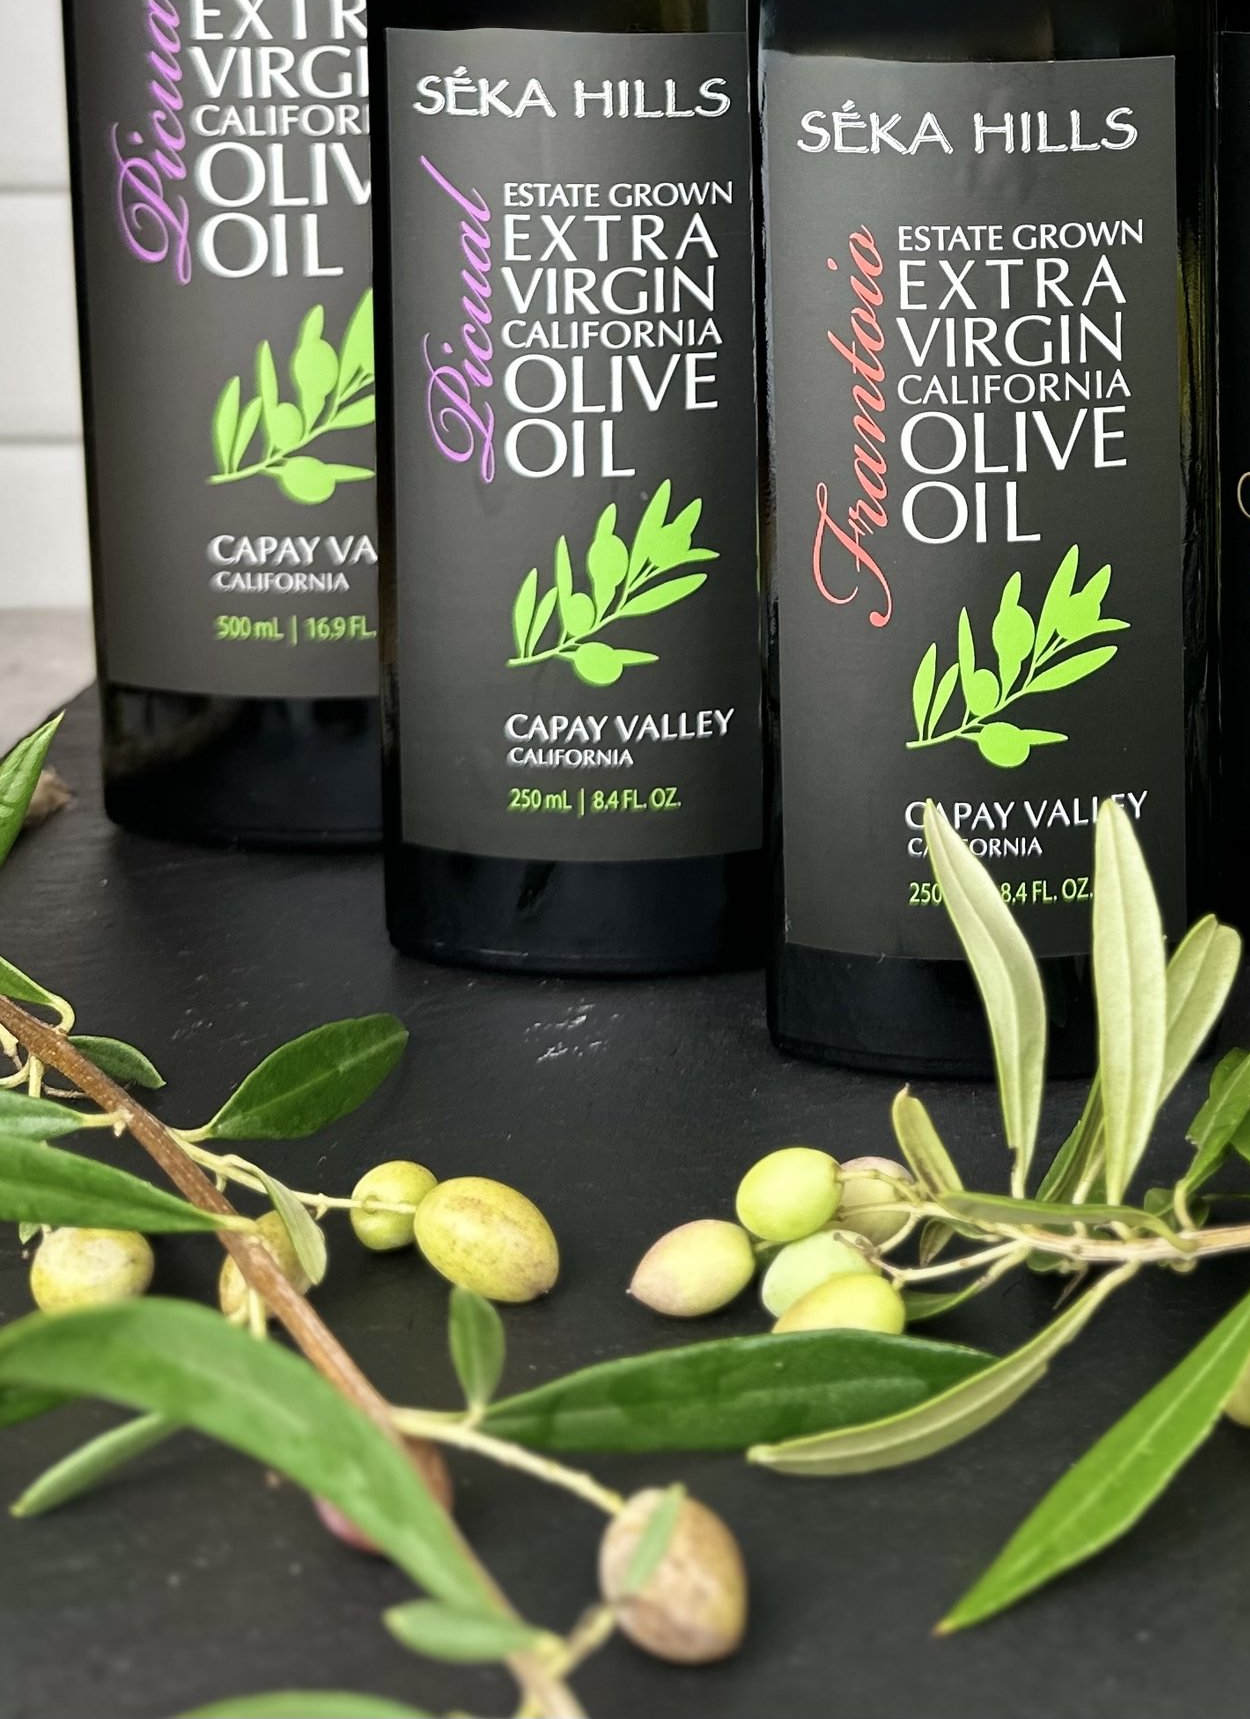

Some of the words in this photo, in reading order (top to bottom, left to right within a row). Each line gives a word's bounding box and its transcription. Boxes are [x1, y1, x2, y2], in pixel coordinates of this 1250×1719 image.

[189, 45, 369, 99] VIRGI
[413, 65, 557, 119] SÉKA
[572, 77, 731, 119] HILLS
[194, 104, 370, 137] CALIFOR
[796, 99, 954, 156] SÉKA
[973, 106, 1138, 155] HILLS
[195, 141, 372, 208] OLIV
[503, 182, 600, 208] ESTATE
[607, 180, 733, 208] GROWN
[197, 212, 344, 278] OIL
[503, 212, 719, 262] EXTRA
[898, 225, 1004, 252] ESTATE
[1011, 218, 1143, 251] GROWN
[500, 265, 715, 315] VIRGIN
[898, 256, 1127, 311] EXTRA
[501, 317, 723, 350] CALIFORNIA
[895, 311, 1122, 373] VIRGIN
[503, 351, 718, 414] OLIVE
[896, 369, 1132, 409] CALIFORNIA
[503, 418, 636, 479] OIL
[811, 223, 893, 629] Frantoio
[899, 401, 1127, 475] OLIVE
[901, 480, 1041, 545] OIL
[208, 534, 321, 565] CAPAY
[213, 571, 350, 593] CALIFORNIA
[215, 615, 253, 640] 500
[252, 619, 282, 641] mL
[504, 713, 609, 744] CAPAY
[613, 707, 735, 743] VALLEY
[507, 746, 634, 768] CALIFORNIA
[507, 788, 543, 812] 250
[543, 791, 571, 813] mL
[590, 790, 620, 813] 8.4
[620, 788, 648, 811] FL.
[649, 786, 682, 812] OZ.
[907, 833, 1043, 861] CORNIA
[1000, 882, 1028, 907] 8.4
[1032, 880, 1058, 904] FL.
[1061, 877, 1095, 905] OZ.
